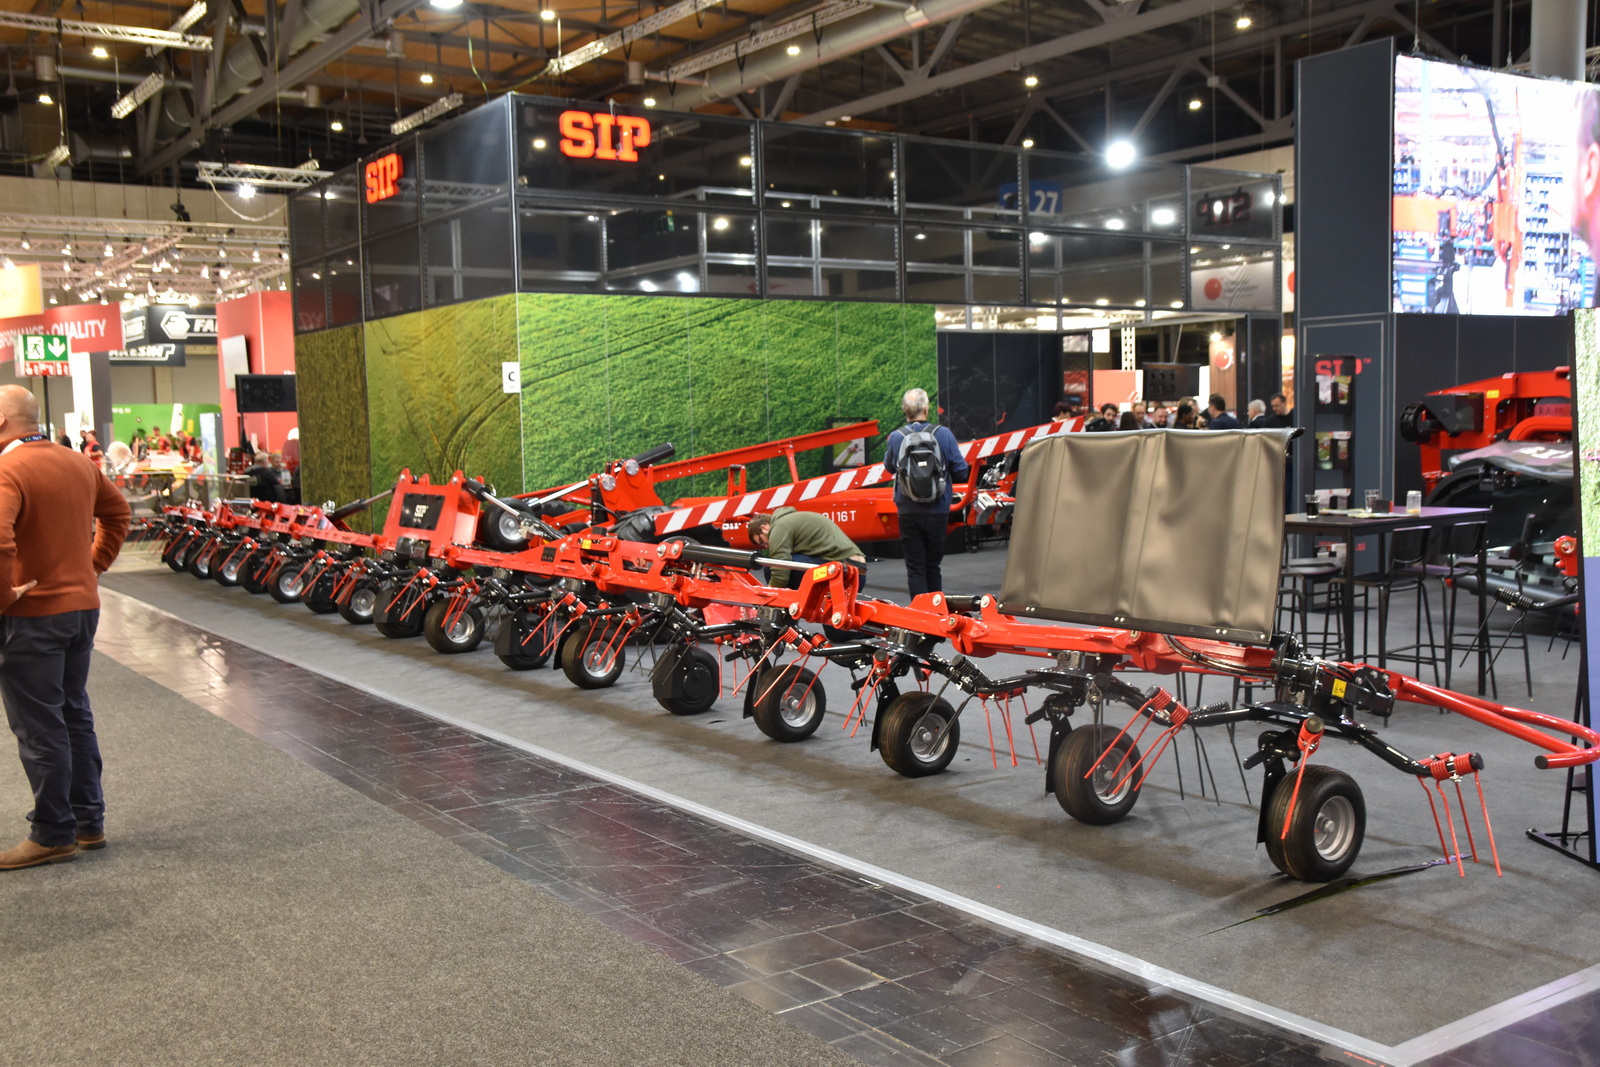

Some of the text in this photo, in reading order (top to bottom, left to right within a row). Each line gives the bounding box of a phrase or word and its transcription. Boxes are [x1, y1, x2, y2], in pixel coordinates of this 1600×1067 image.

[559, 110, 650, 162] SIP
[366, 152, 401, 204] SIP
[51, 319, 107, 340] QUALITY
